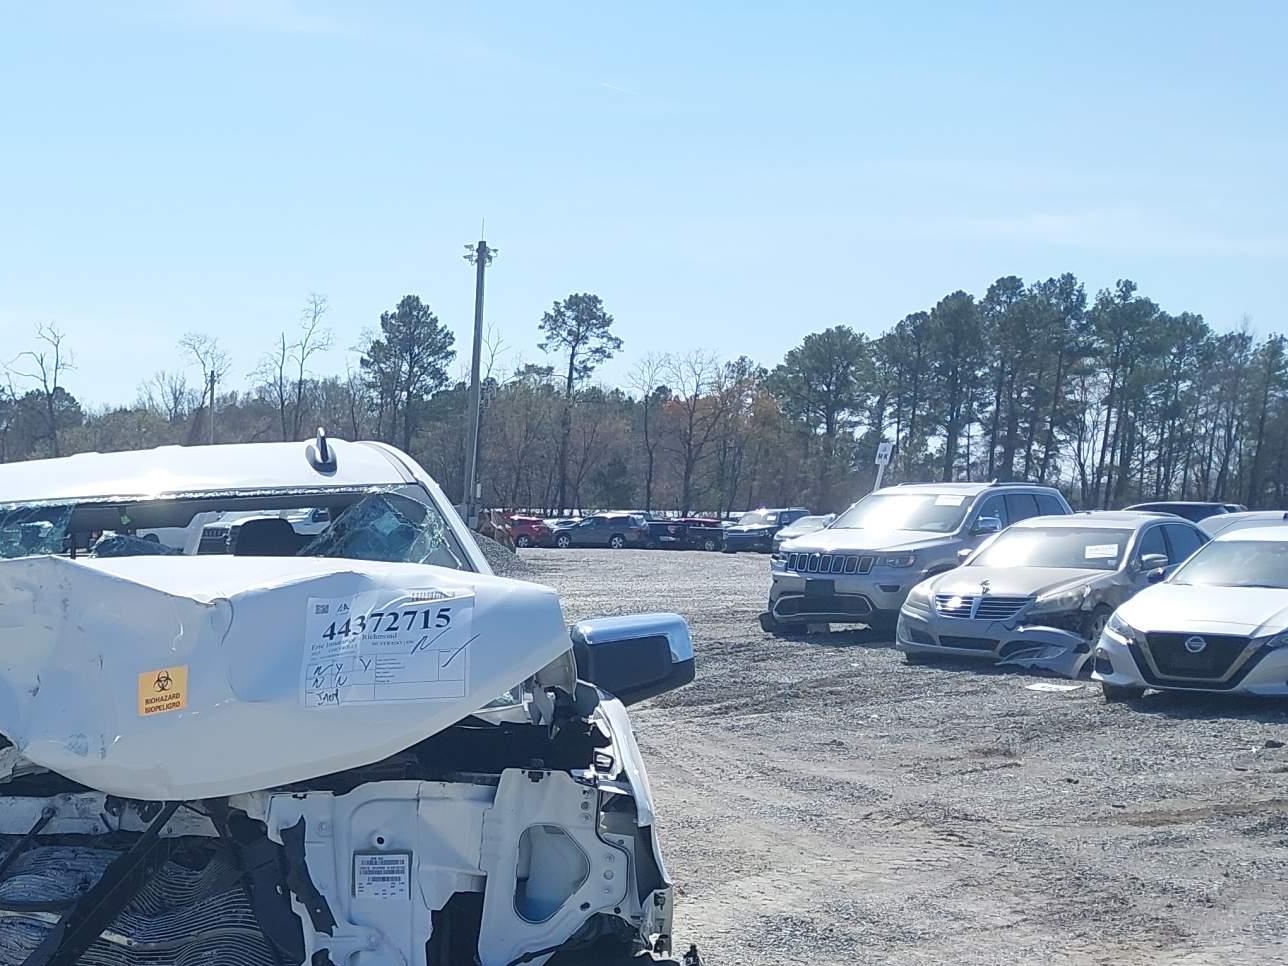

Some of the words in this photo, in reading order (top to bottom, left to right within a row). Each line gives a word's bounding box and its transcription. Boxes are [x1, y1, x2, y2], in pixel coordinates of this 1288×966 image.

[322, 607, 452, 641] 44372715
[361, 631, 398, 641] Richmond
[144, 692, 181, 705] BIOHAZARD
[144, 701, 181, 713] BIOPELIGRO
